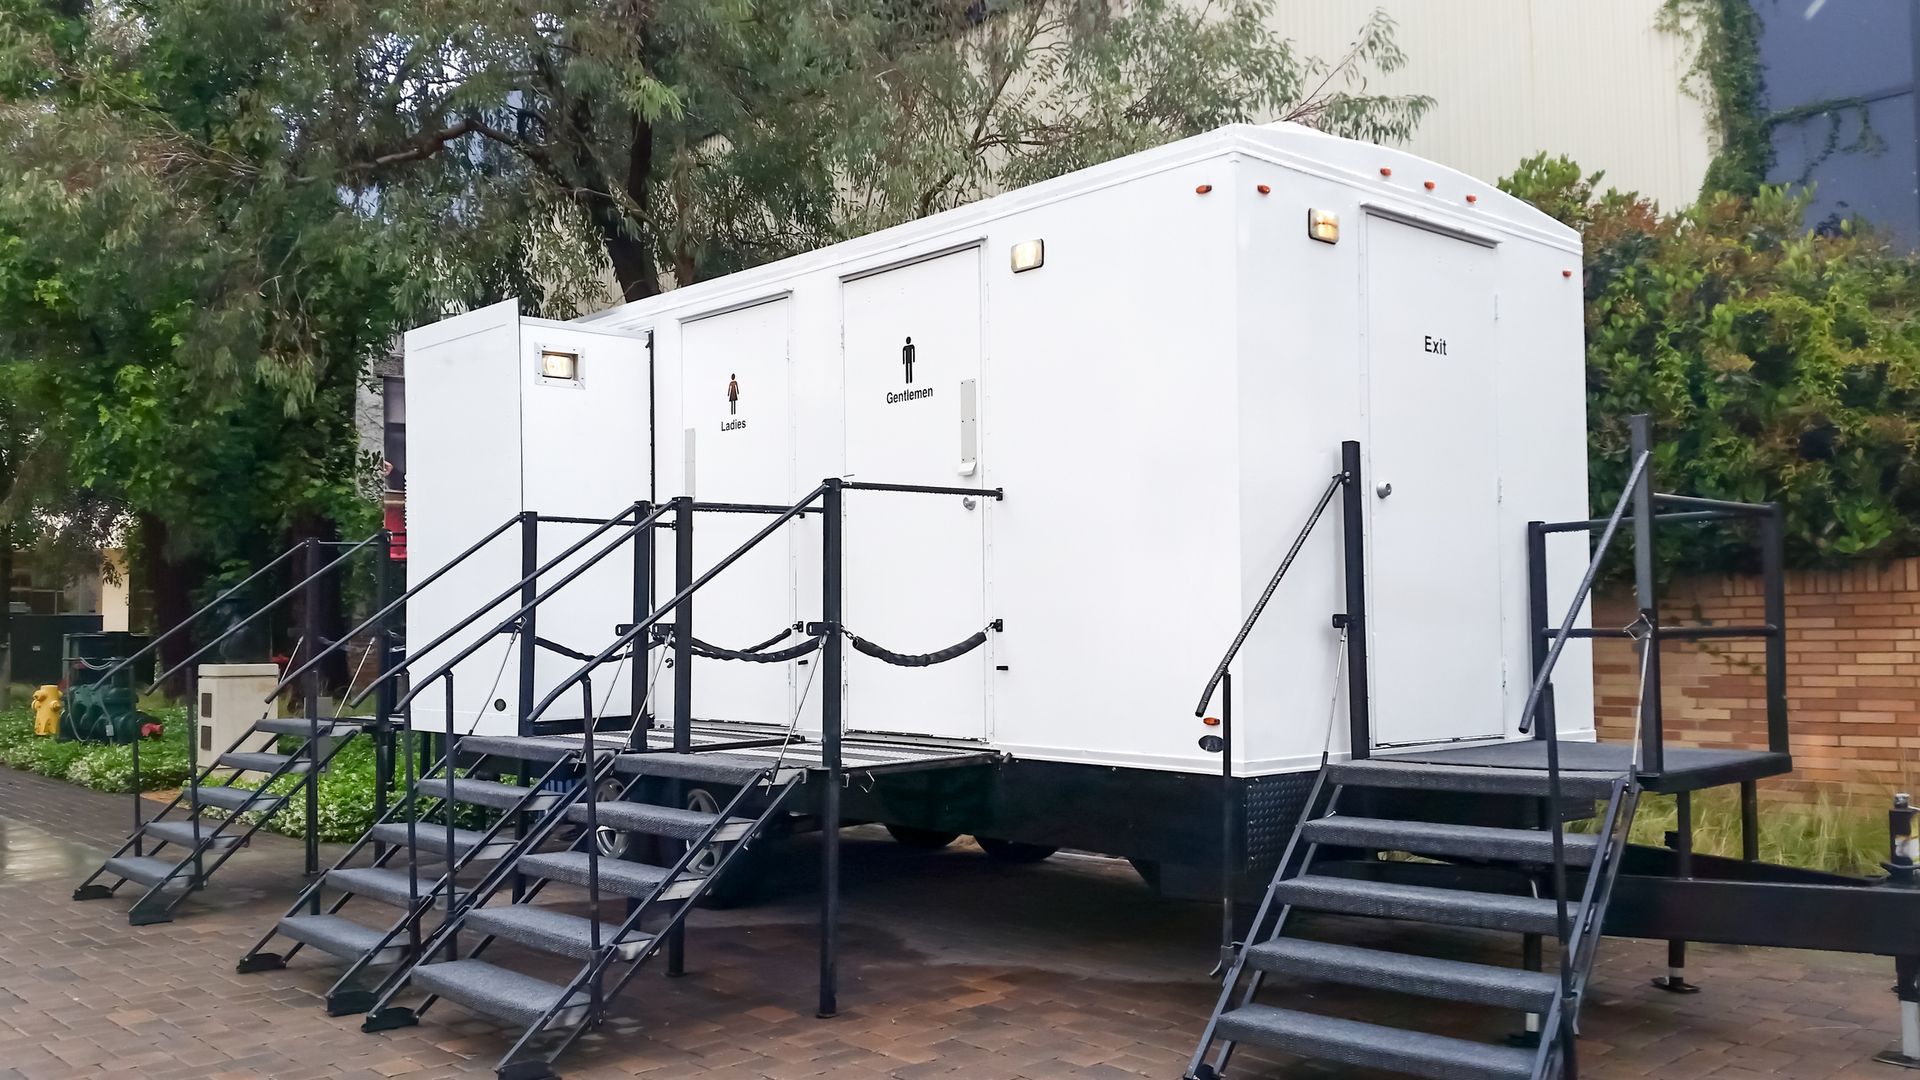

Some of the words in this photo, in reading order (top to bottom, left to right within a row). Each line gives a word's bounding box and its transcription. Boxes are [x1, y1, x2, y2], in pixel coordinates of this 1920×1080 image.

[1424, 335, 1448, 356] Exit
[886, 387, 934, 404] Gentlemen
[720, 419, 747, 432] Ladies
